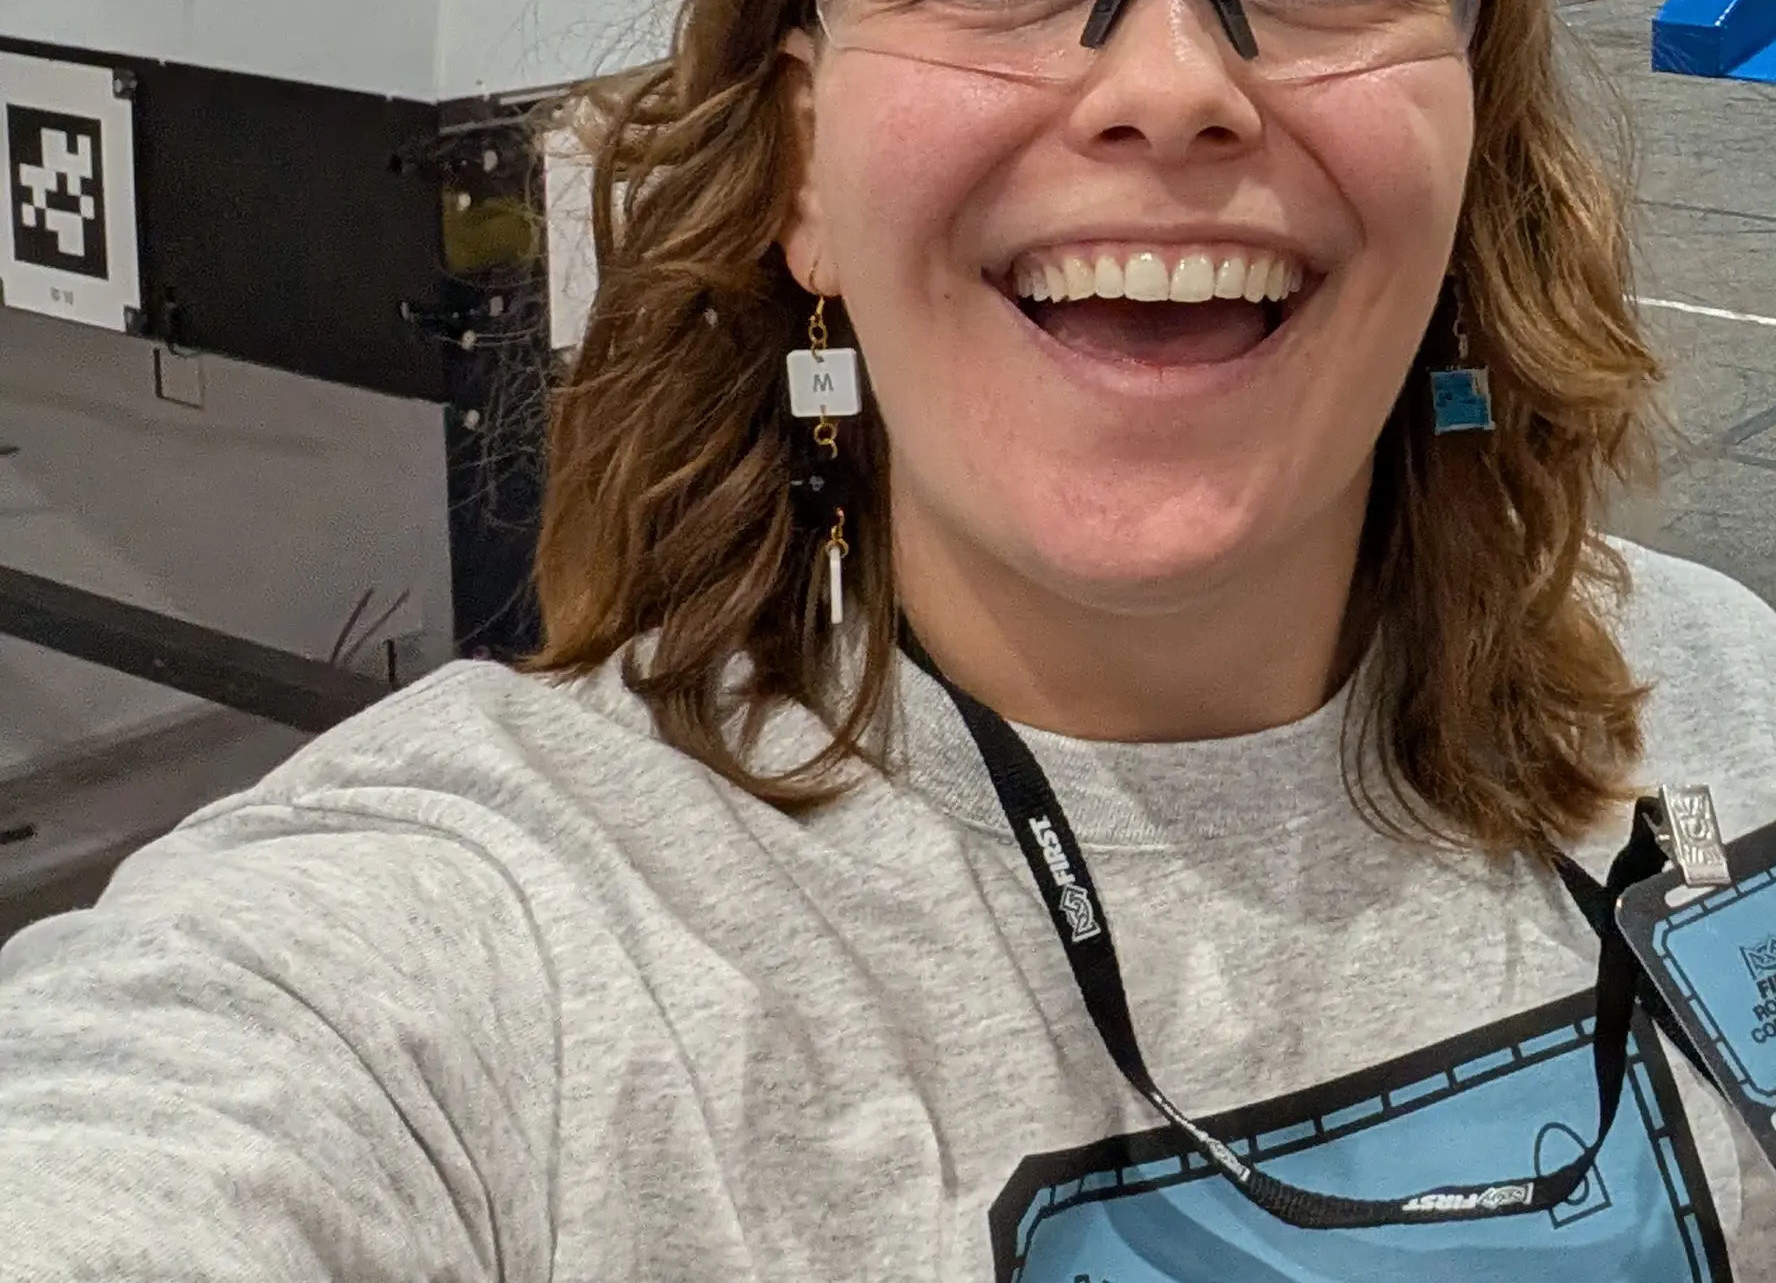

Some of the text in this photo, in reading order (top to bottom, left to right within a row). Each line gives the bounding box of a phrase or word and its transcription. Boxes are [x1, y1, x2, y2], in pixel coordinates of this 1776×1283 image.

[813, 373, 834, 393] M
[1028, 814, 1076, 886] FIRST
[1401, 1192, 1479, 1212] FIRST
